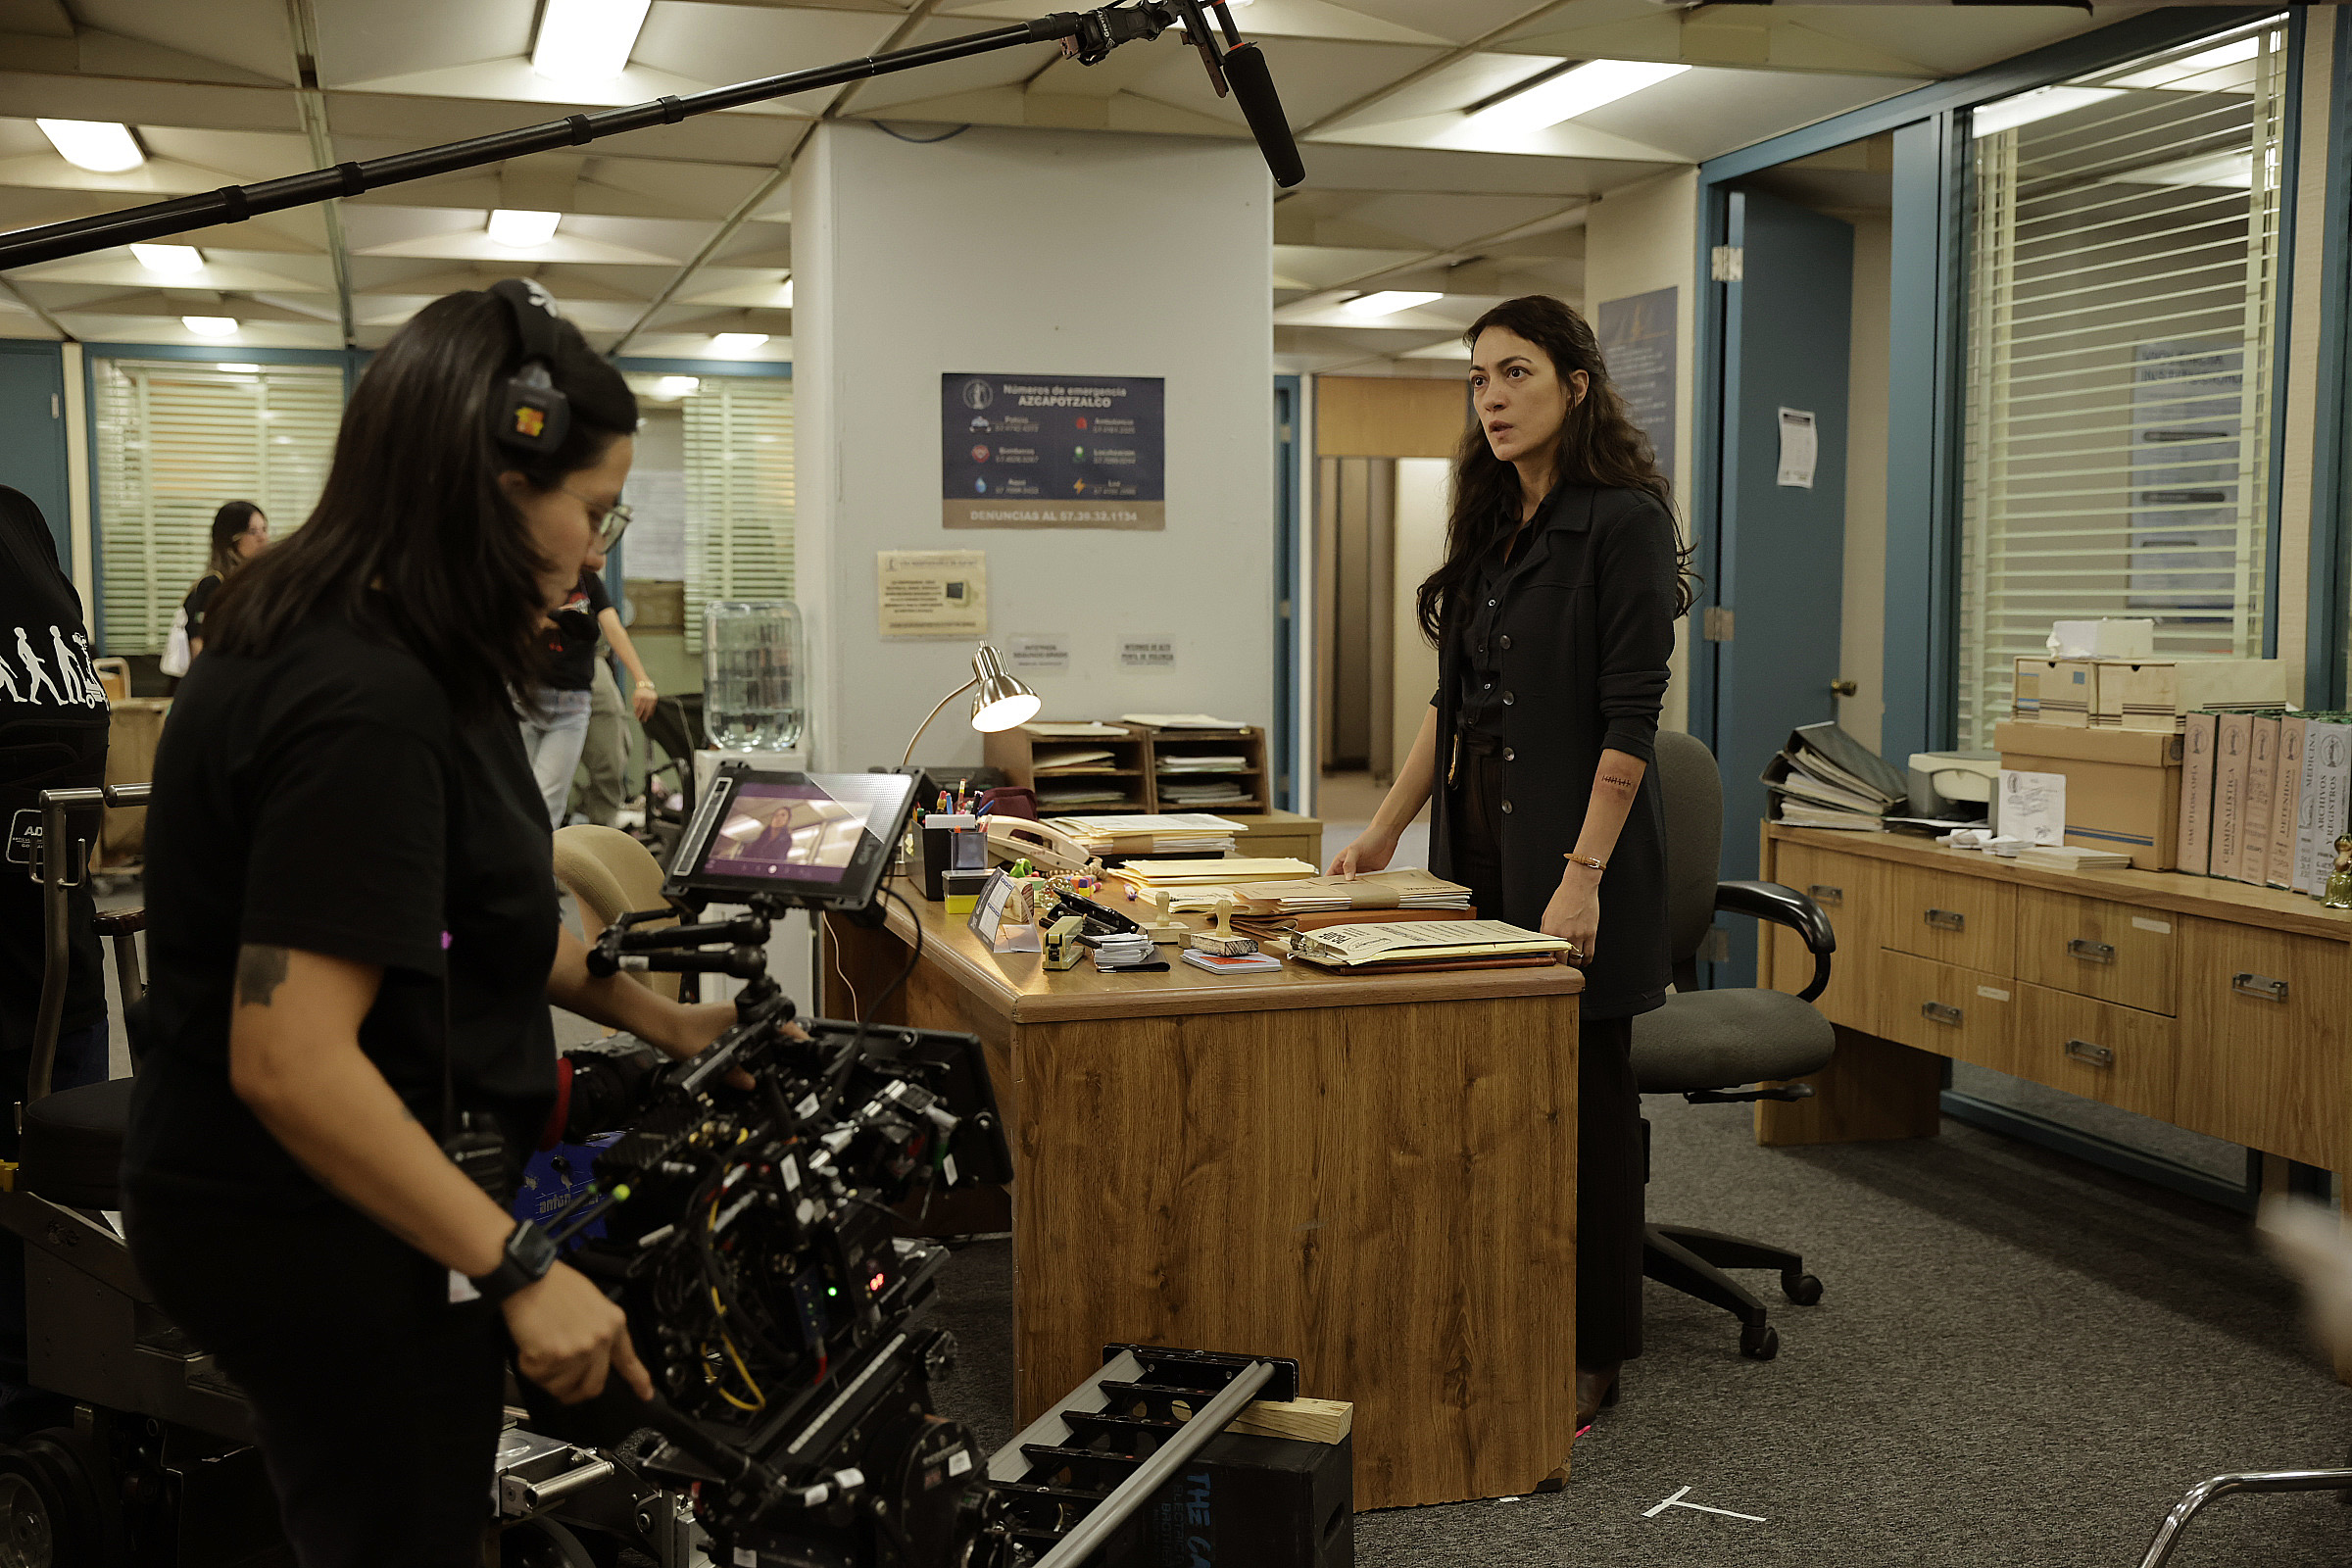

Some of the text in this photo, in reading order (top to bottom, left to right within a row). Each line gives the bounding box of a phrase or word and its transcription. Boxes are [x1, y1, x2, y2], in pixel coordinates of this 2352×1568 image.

[1018, 395, 1111, 408] AZCAPOTZALCO
[1052, 384, 1065, 396] de
[1066, 386, 1127, 398] emergencia
[970, 511, 1040, 521] DENUNCIAS
[1042, 511, 1057, 521] AL
[2306, 733, 2317, 787] MEDICINA
[2317, 774, 2328, 830] ARCHIVOS
[2327, 776, 2337, 835] REGISTROS
[1187, 1473, 1210, 1527] THE
